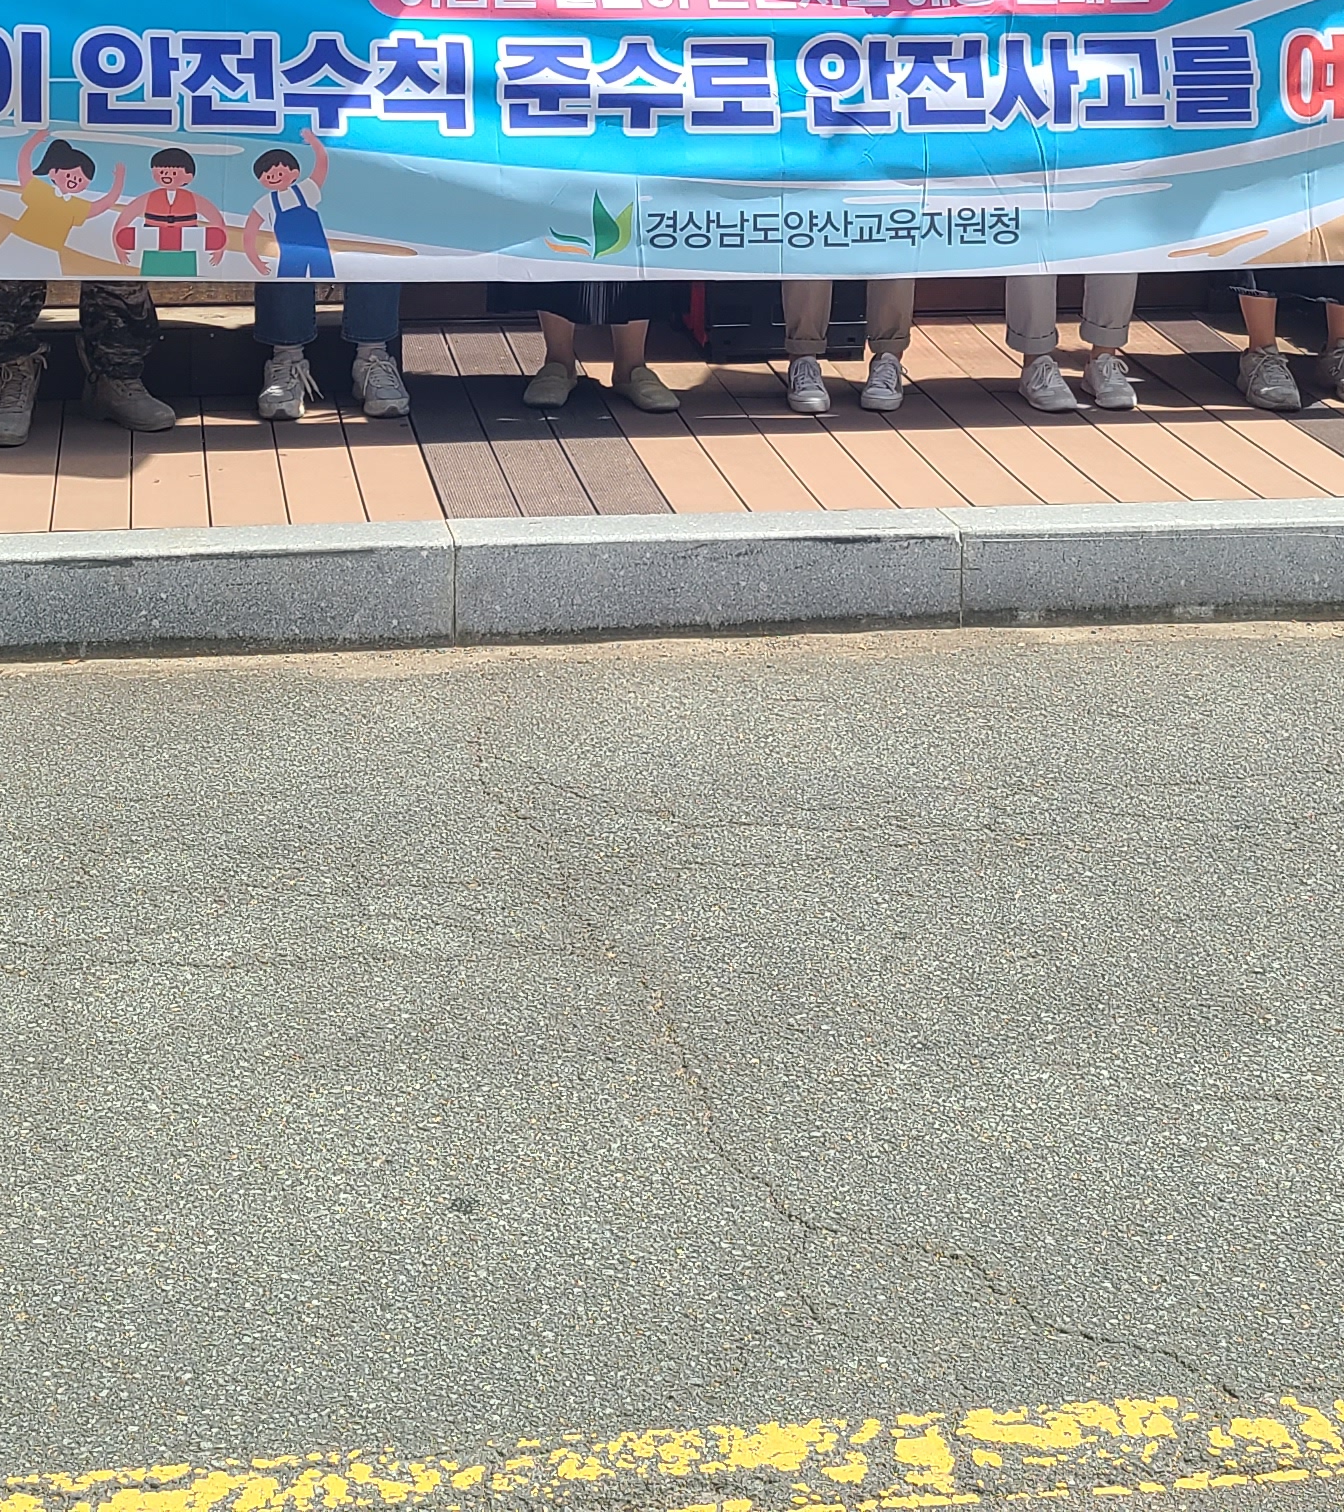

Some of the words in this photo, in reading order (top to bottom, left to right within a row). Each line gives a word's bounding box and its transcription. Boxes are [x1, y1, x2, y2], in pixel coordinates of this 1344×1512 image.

[78, 31, 468, 131] 안전수칙
[501, 38, 777, 131] 준수로
[802, 36, 1255, 128] 안전사고를
[645, 205, 1022, 250] 경상남도양산교육지원청
